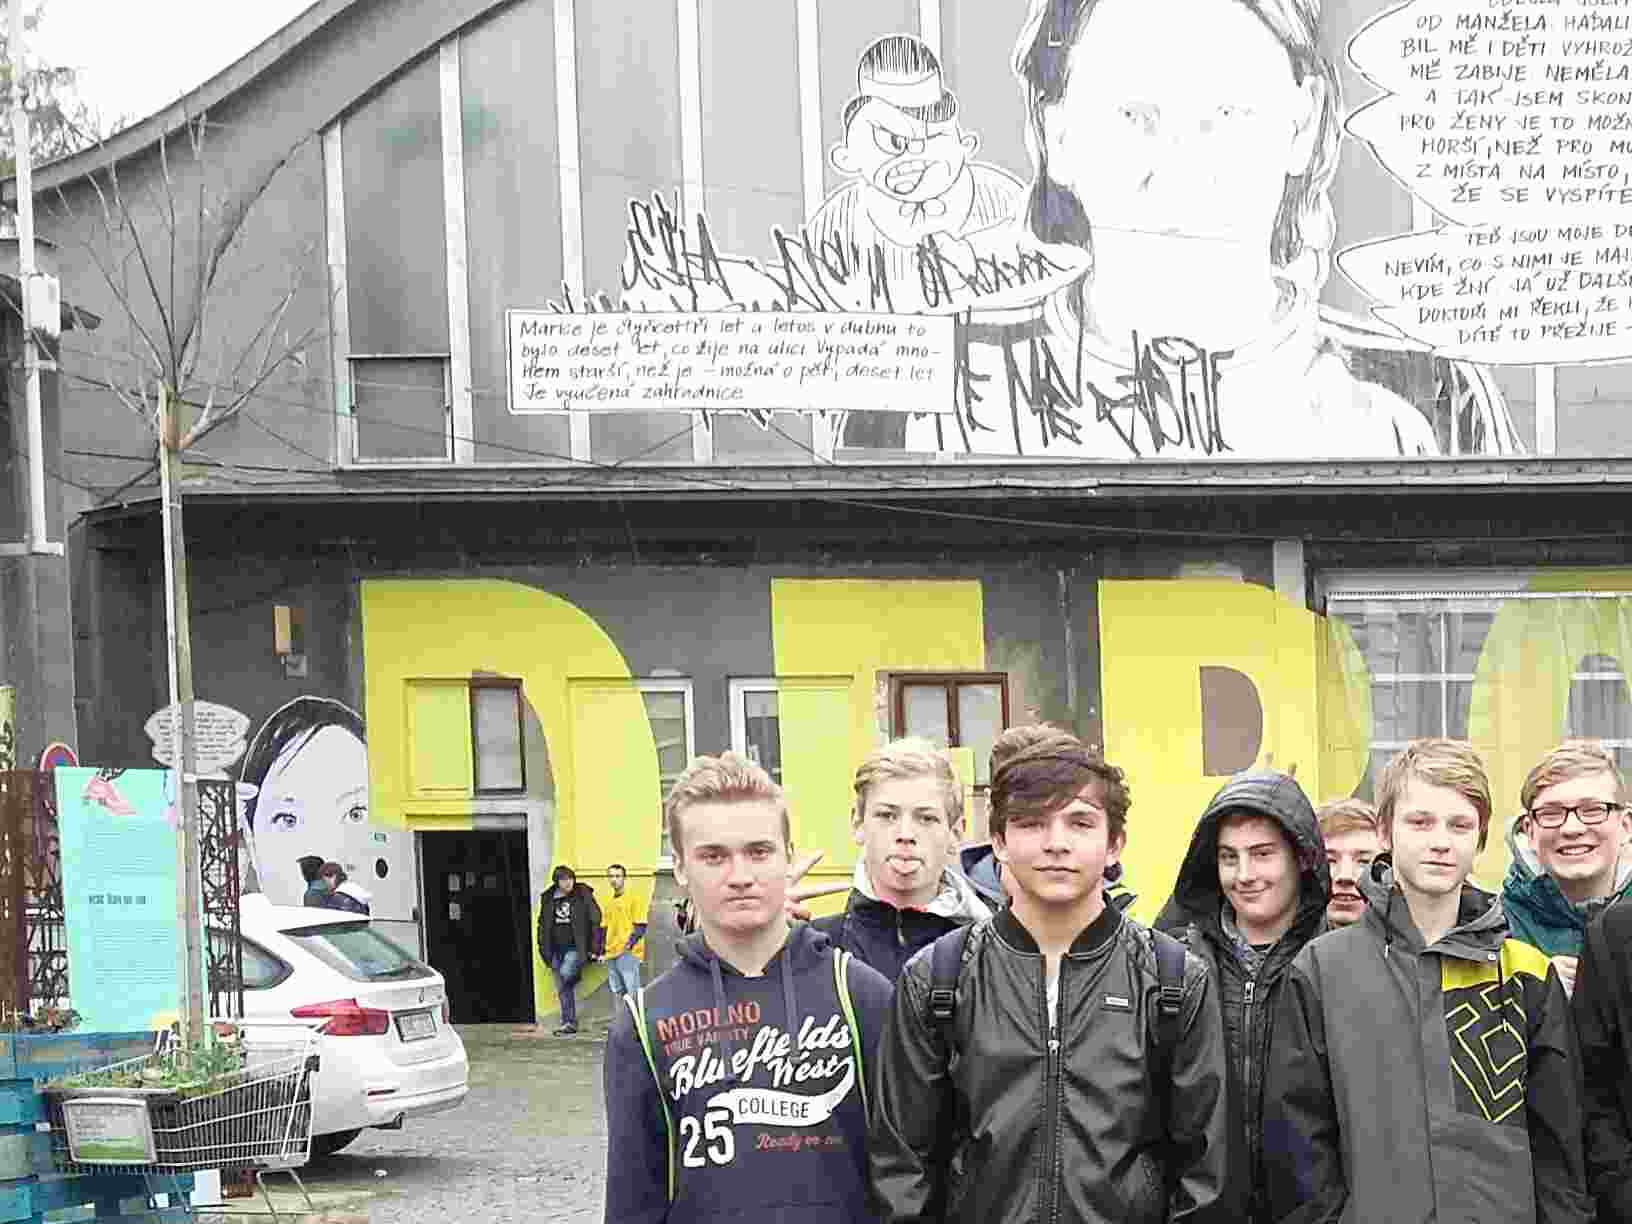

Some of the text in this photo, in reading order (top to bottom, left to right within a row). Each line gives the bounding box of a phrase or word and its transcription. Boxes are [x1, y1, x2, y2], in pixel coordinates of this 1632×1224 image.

[1416, 15, 1444, 31] OD
[1456, 9, 1548, 31] MANŽELA
[1401, 37, 1438, 58] BIL
[1449, 32, 1479, 55] MĚ
[1502, 34, 1547, 57] DĚTI
[1410, 58, 1441, 81] MĚ
[1546, 59, 1630, 82] NEMĚLA
[1449, 109, 1507, 131] ŽENY
[1519, 164, 1546, 180] NA
[1451, 182, 1484, 204] ŽE
[1500, 186, 1530, 203] SE
[720, 317, 745, 334] let
[737, 1096, 810, 1119] COLLEGE
[679, 1108, 737, 1168] 25
